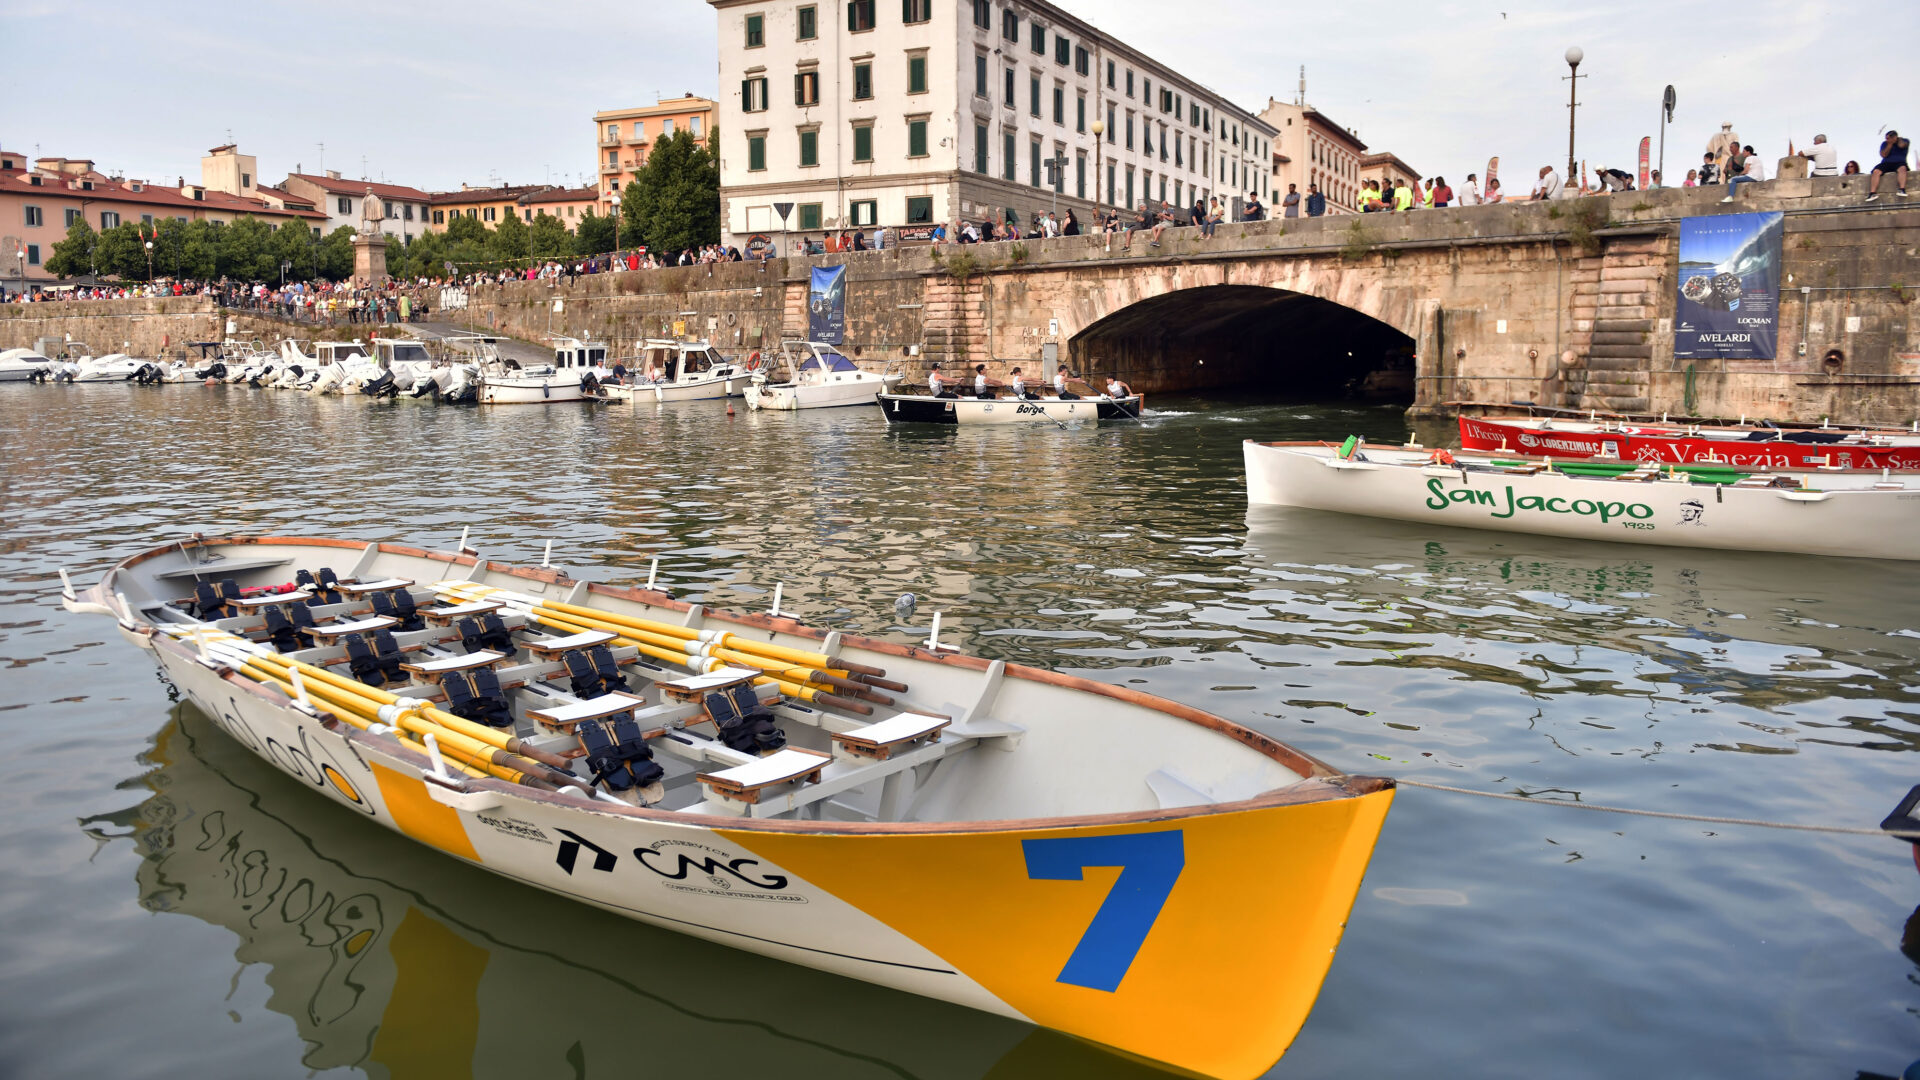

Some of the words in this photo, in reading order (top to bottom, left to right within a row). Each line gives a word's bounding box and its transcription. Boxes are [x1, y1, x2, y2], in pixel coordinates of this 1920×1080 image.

[1737, 317, 1772, 325] LOCMAN
[1698, 333, 1751, 343] AVELARDI
[892, 400, 900, 412] 1
[1016, 404, 1044, 416] Borgo
[1667, 443, 1790, 468] Venezia
[1426, 478, 1496, 510] San
[1491, 486, 1654, 523] Jacopo
[1622, 521, 1655, 530] 1925
[650, 839, 730, 859] MULTISERVICE
[633, 847, 788, 890] CMG
[665, 883, 706, 895] CONTROL
[708, 889, 776, 901] MAINTENANCE
[1021, 829, 1185, 993] 7
